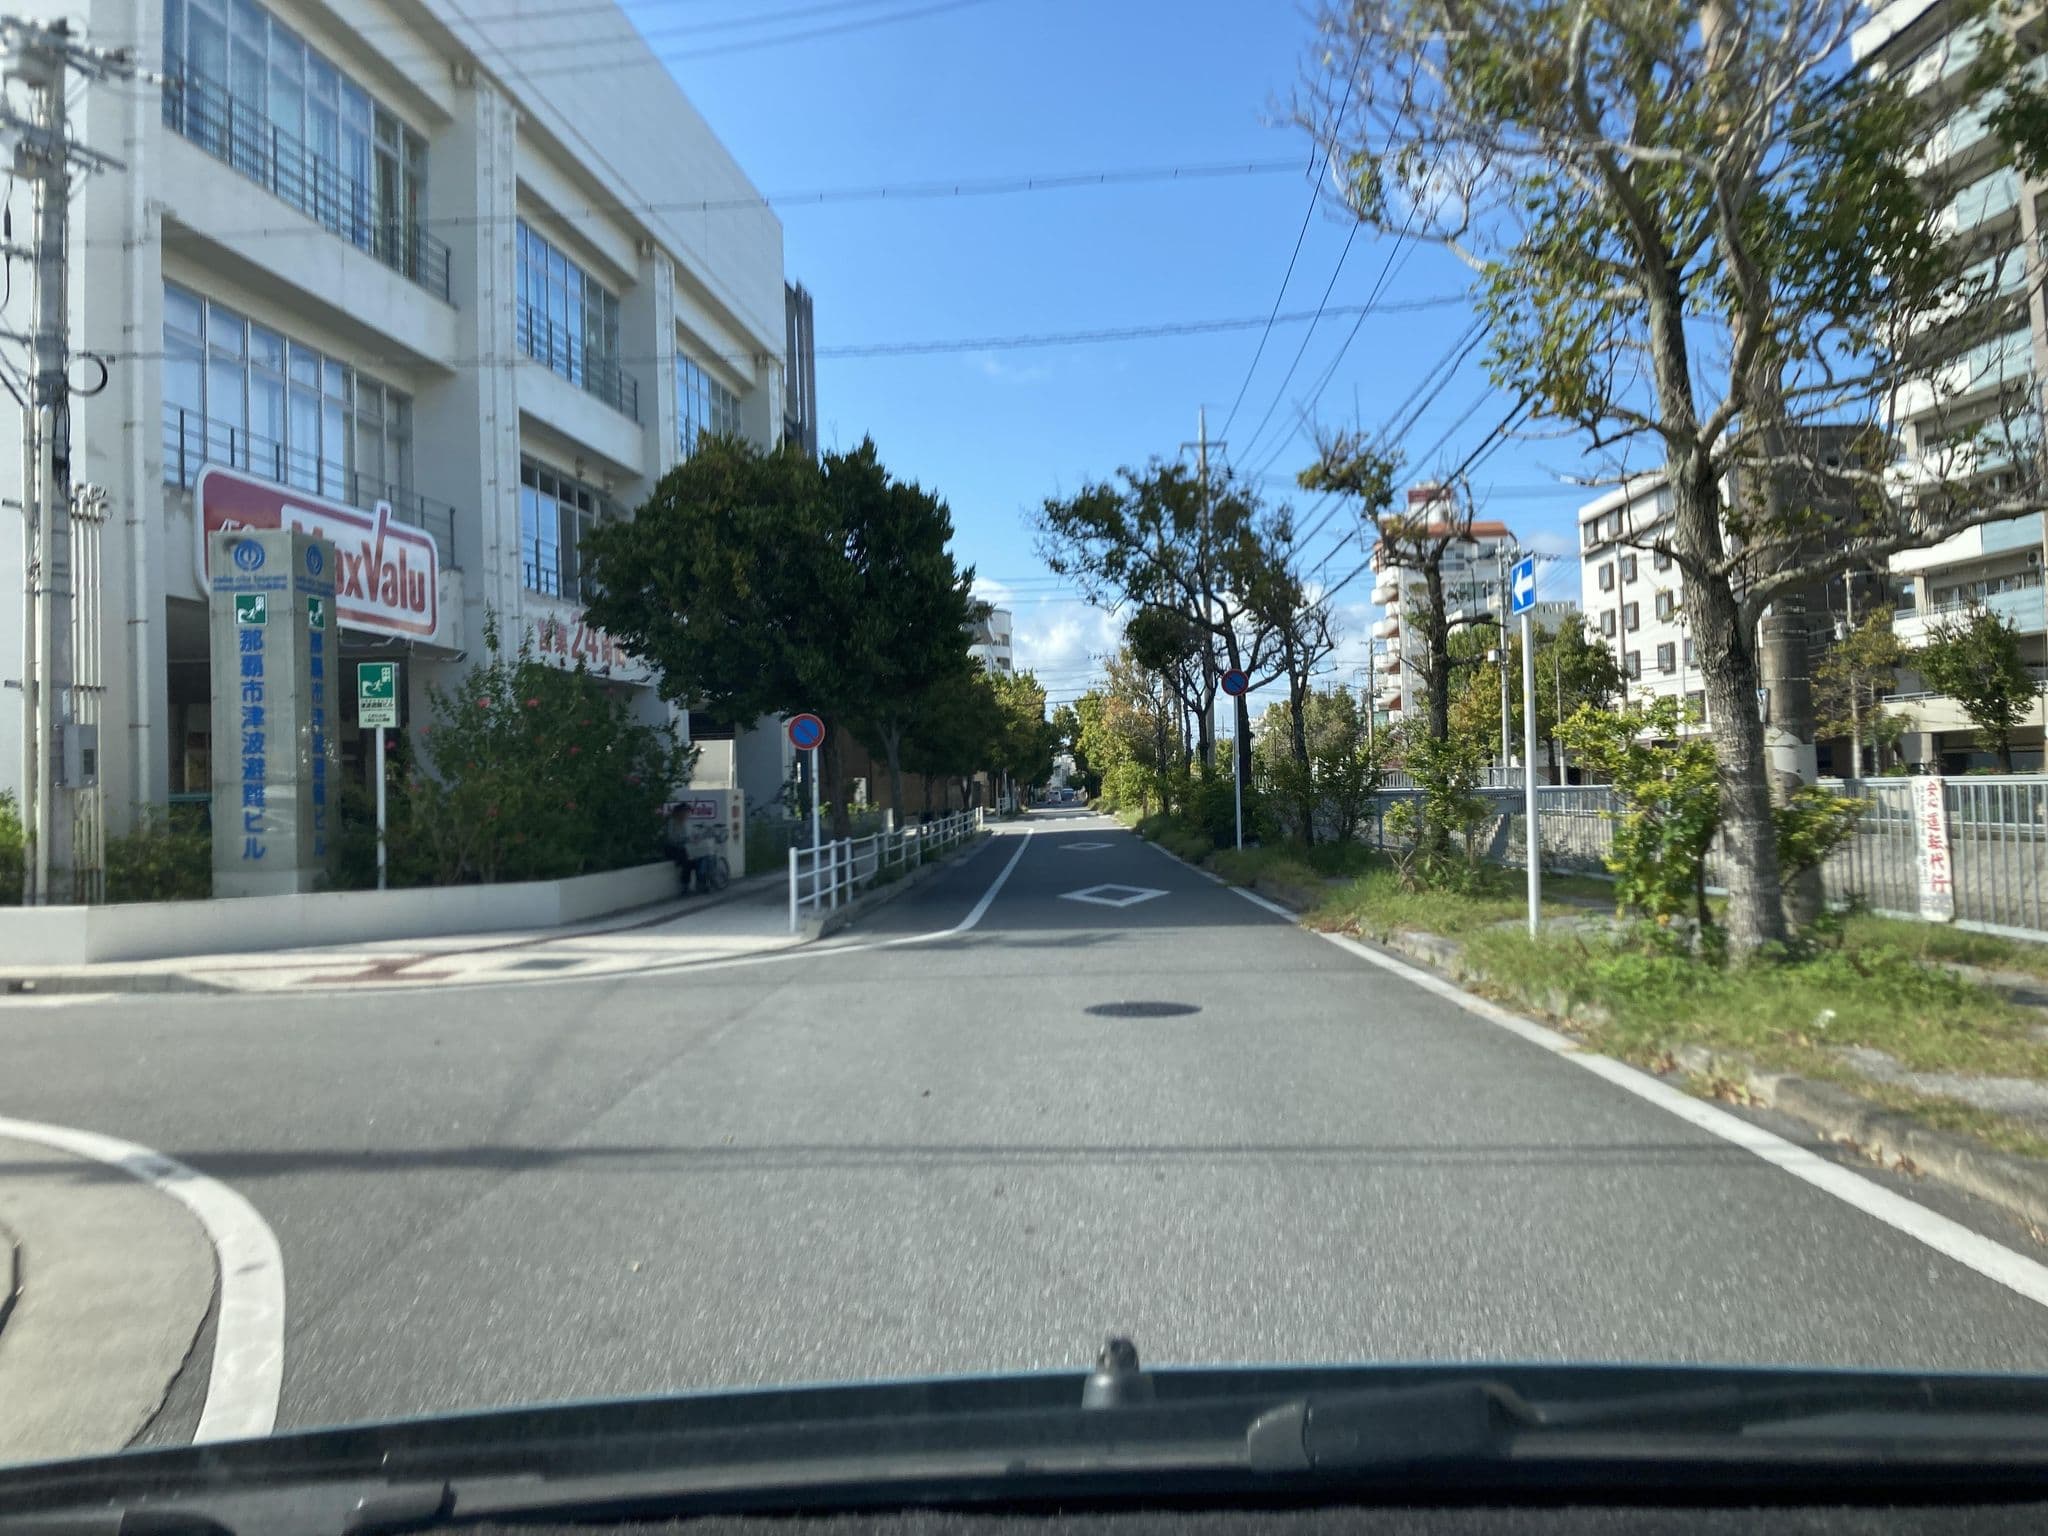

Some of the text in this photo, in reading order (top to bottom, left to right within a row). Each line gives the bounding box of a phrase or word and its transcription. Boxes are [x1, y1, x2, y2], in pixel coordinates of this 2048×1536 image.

[292, 508, 426, 614] xValu
[239, 628, 266, 861] 那覇市津波避難ビル
